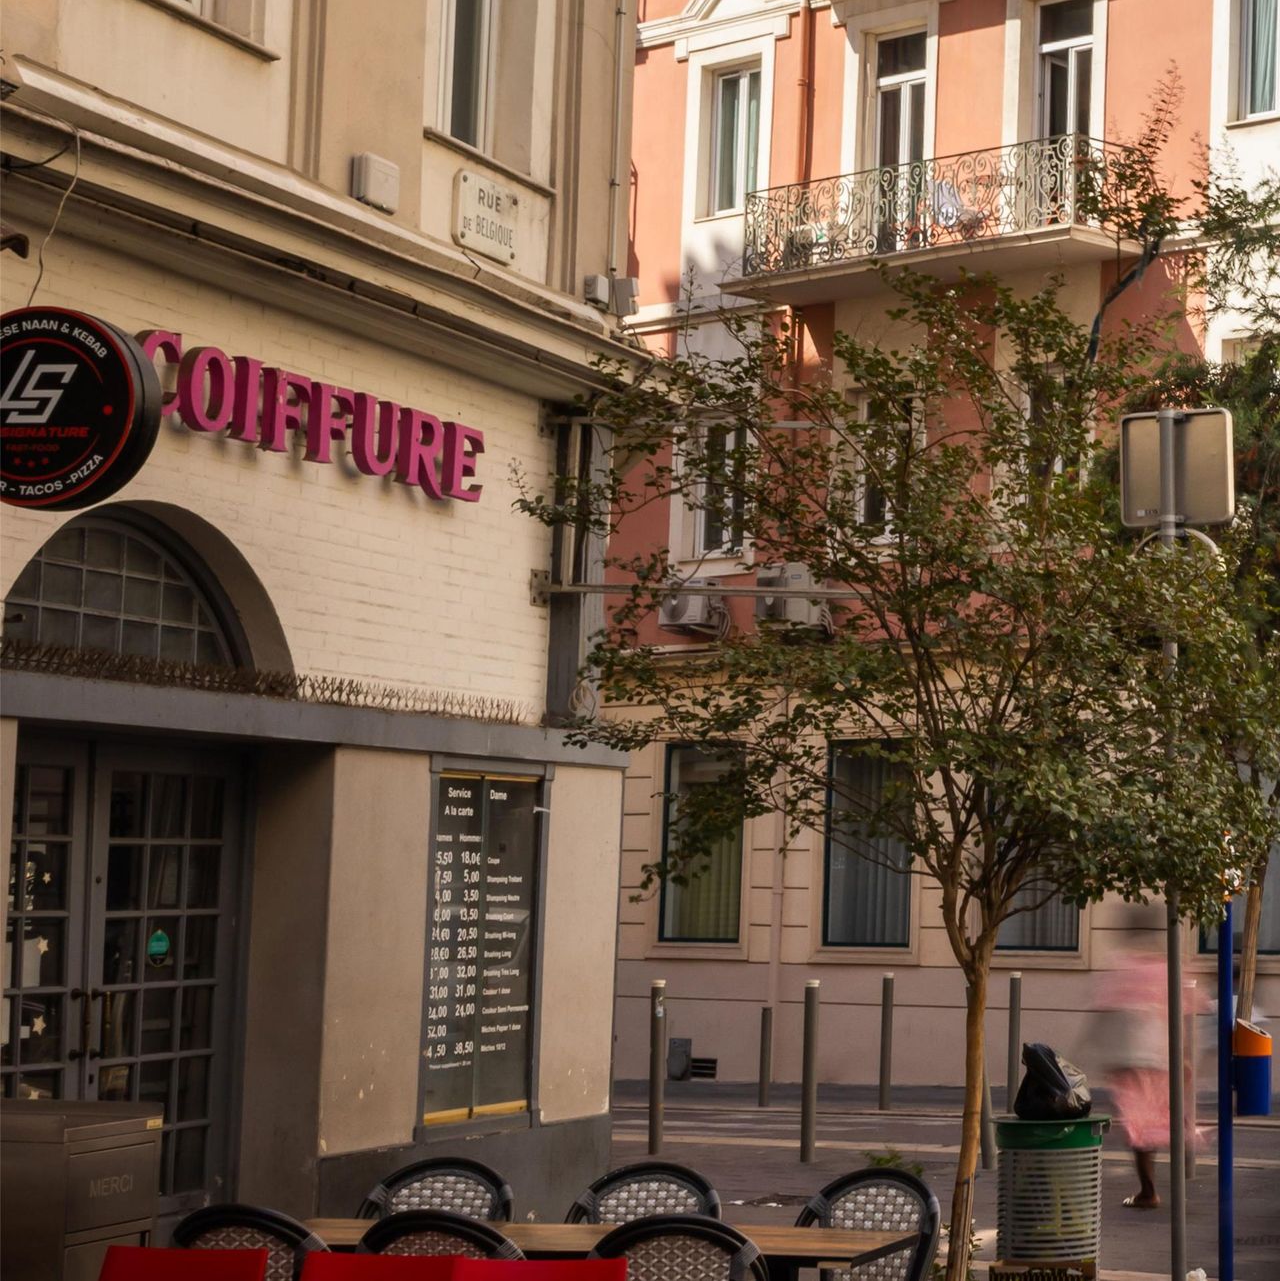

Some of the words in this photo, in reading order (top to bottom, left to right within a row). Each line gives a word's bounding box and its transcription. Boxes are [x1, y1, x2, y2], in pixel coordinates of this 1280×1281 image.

[478, 188, 501, 213] RUE
[463, 216, 472, 231] DE
[476, 215, 513, 248] BELGIQUE
[22, 320, 58, 331] NAAN
[61, 323, 69, 333] &
[72, 327, 108, 358] KEBAB
[135, 329, 485, 502] COIFFURE
[20, 480, 63, 496] TACOS
[448, 787, 472, 798] Service
[490, 789, 507, 800] Dame
[444, 805, 450, 815] A
[451, 806, 457, 816] la
[458, 806, 474, 817] carte
[89, 1174, 134, 1199] MERCI
